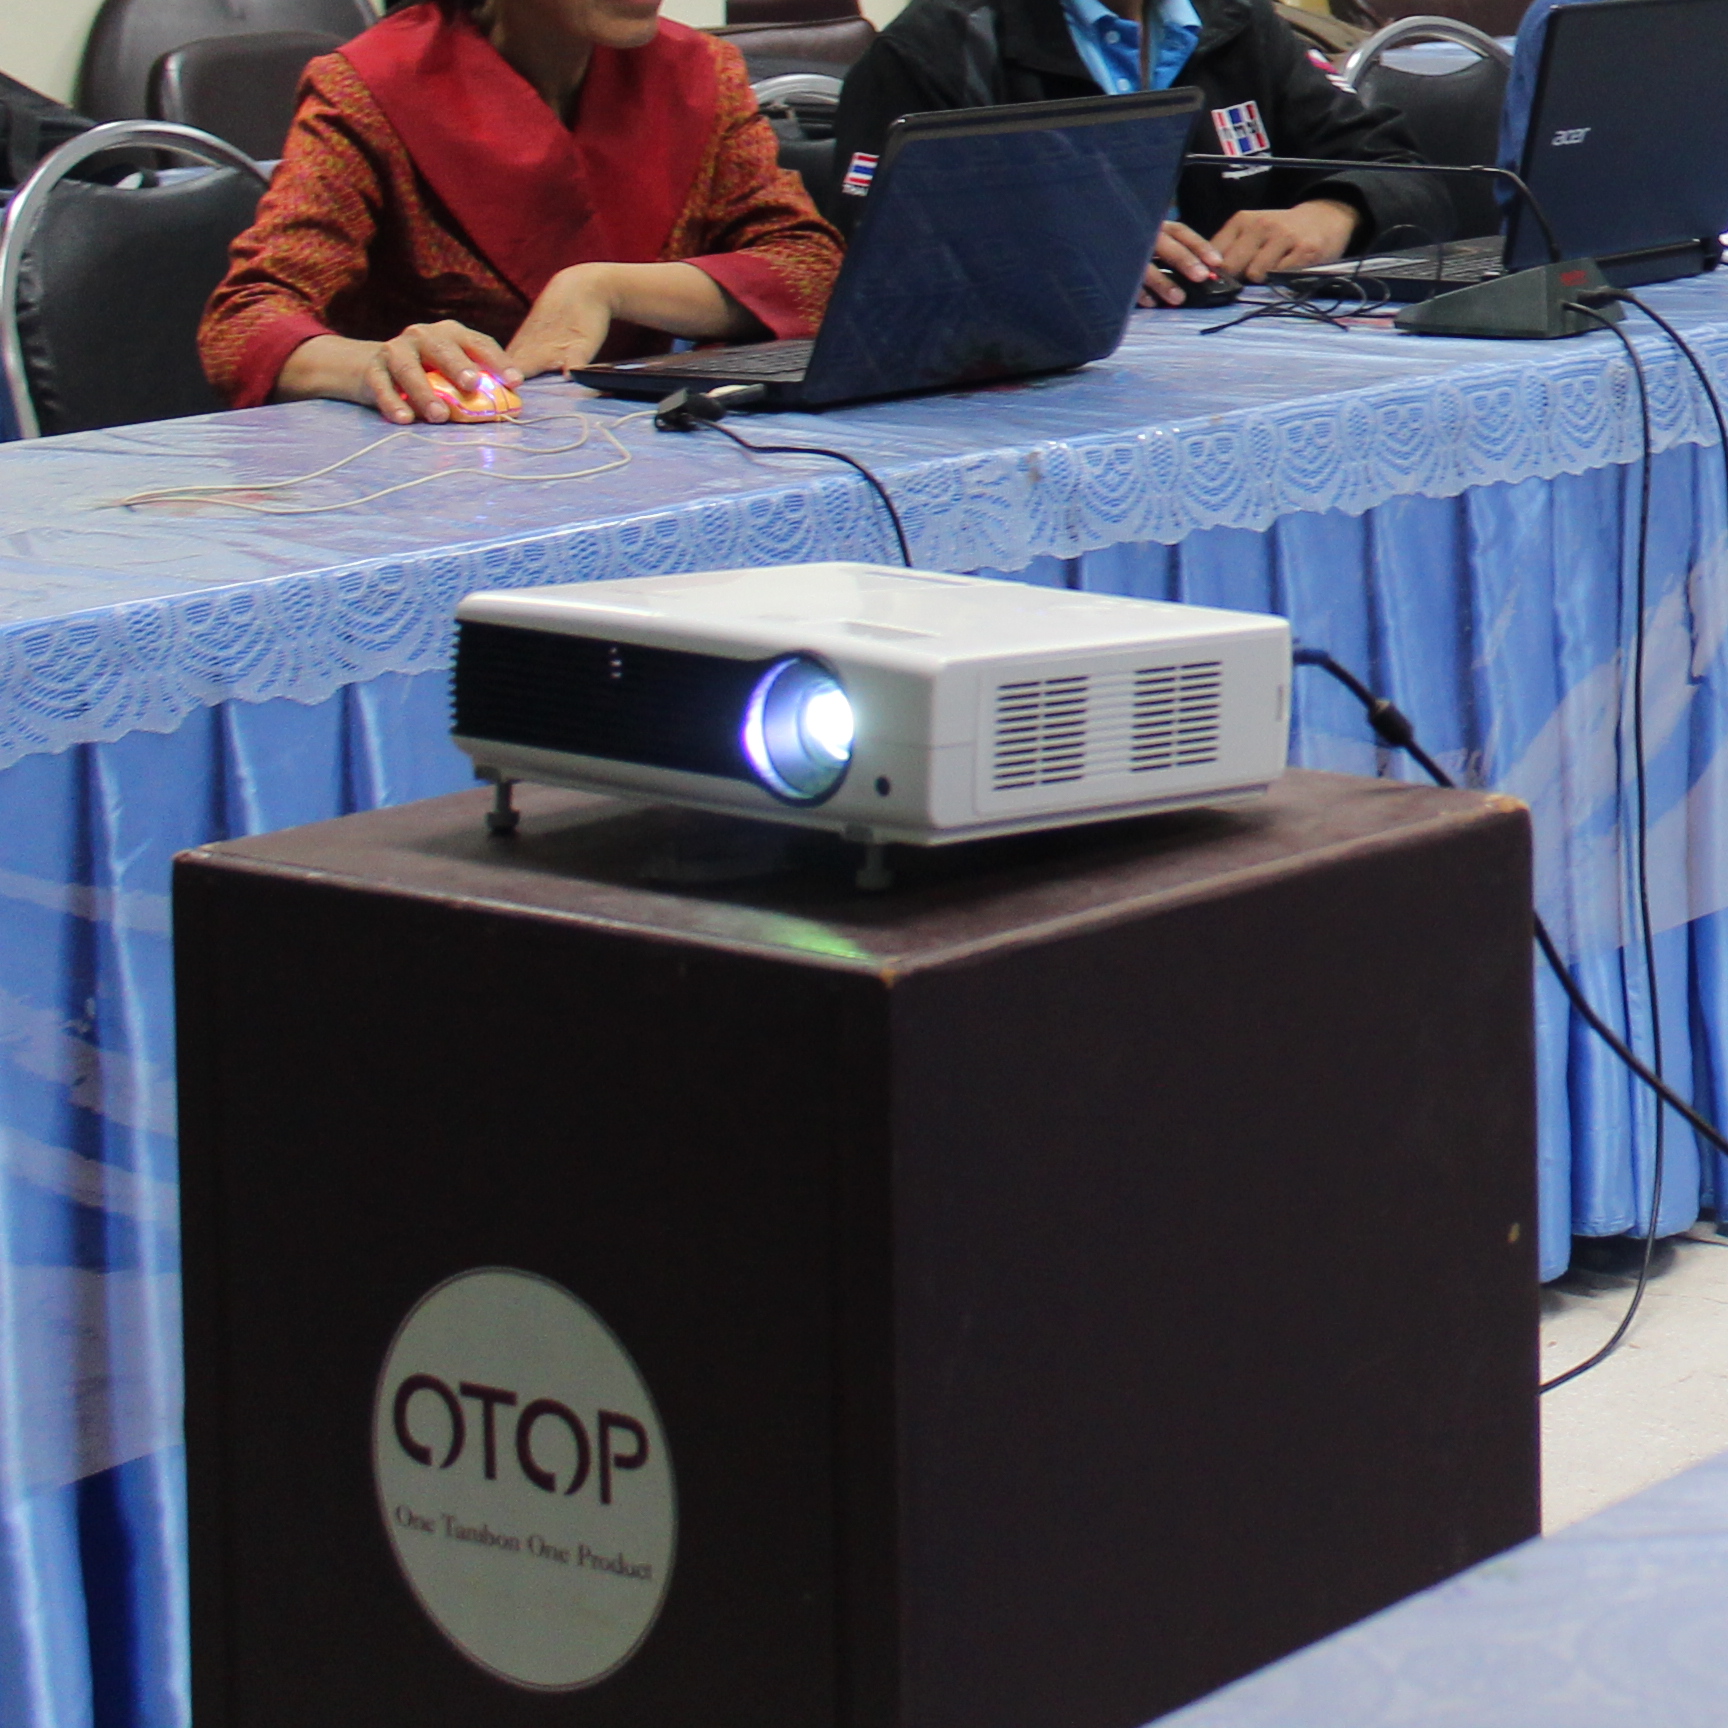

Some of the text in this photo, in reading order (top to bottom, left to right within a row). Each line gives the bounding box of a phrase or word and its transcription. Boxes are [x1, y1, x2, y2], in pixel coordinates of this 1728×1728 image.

[1551, 127, 1592, 146] acer
[392, 1372, 650, 1506] OTOP
[394, 1504, 653, 1581] One Tambon One Product
